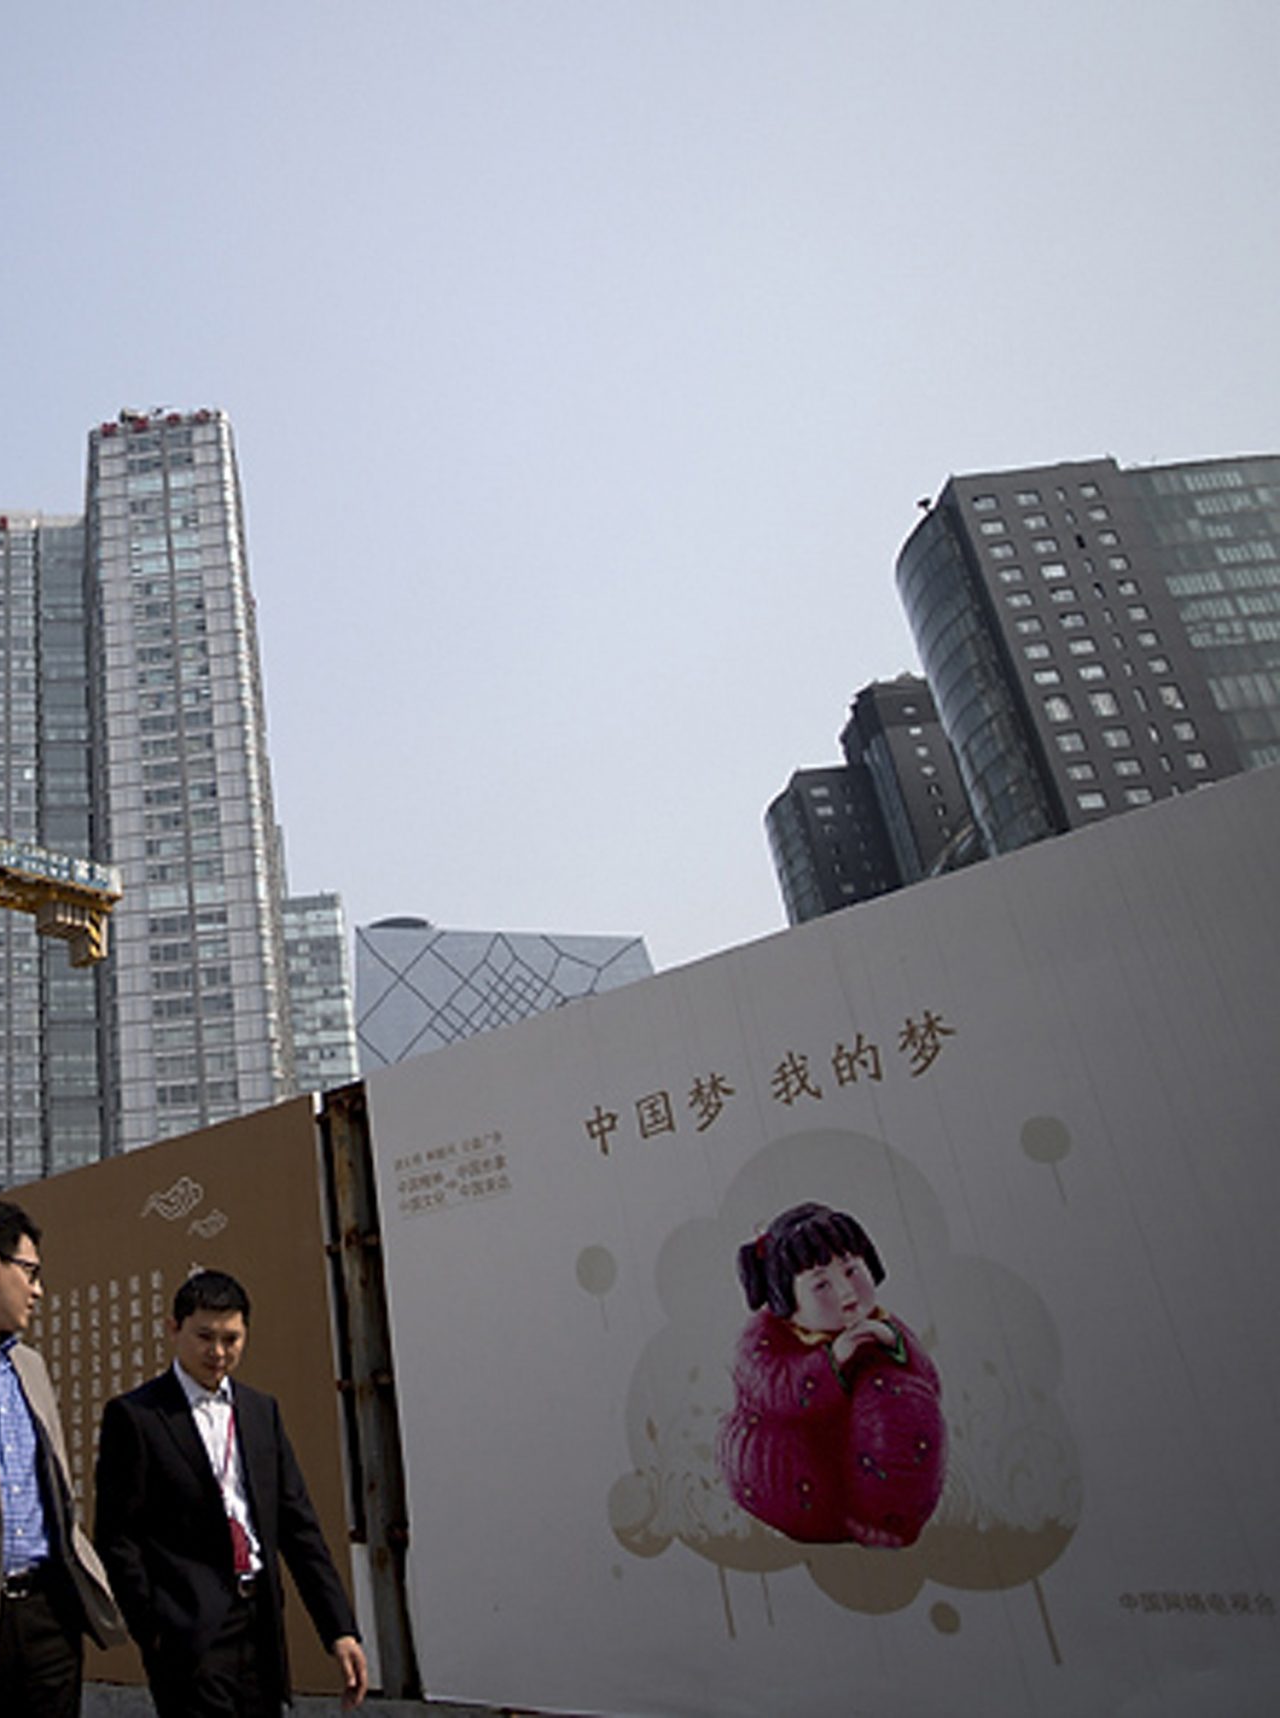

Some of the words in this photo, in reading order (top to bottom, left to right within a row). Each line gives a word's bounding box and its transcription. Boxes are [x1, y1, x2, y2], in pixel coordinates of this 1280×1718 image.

[584, 1073, 736, 1157] 中国梦
[771, 1009, 958, 1105] 我的梦
